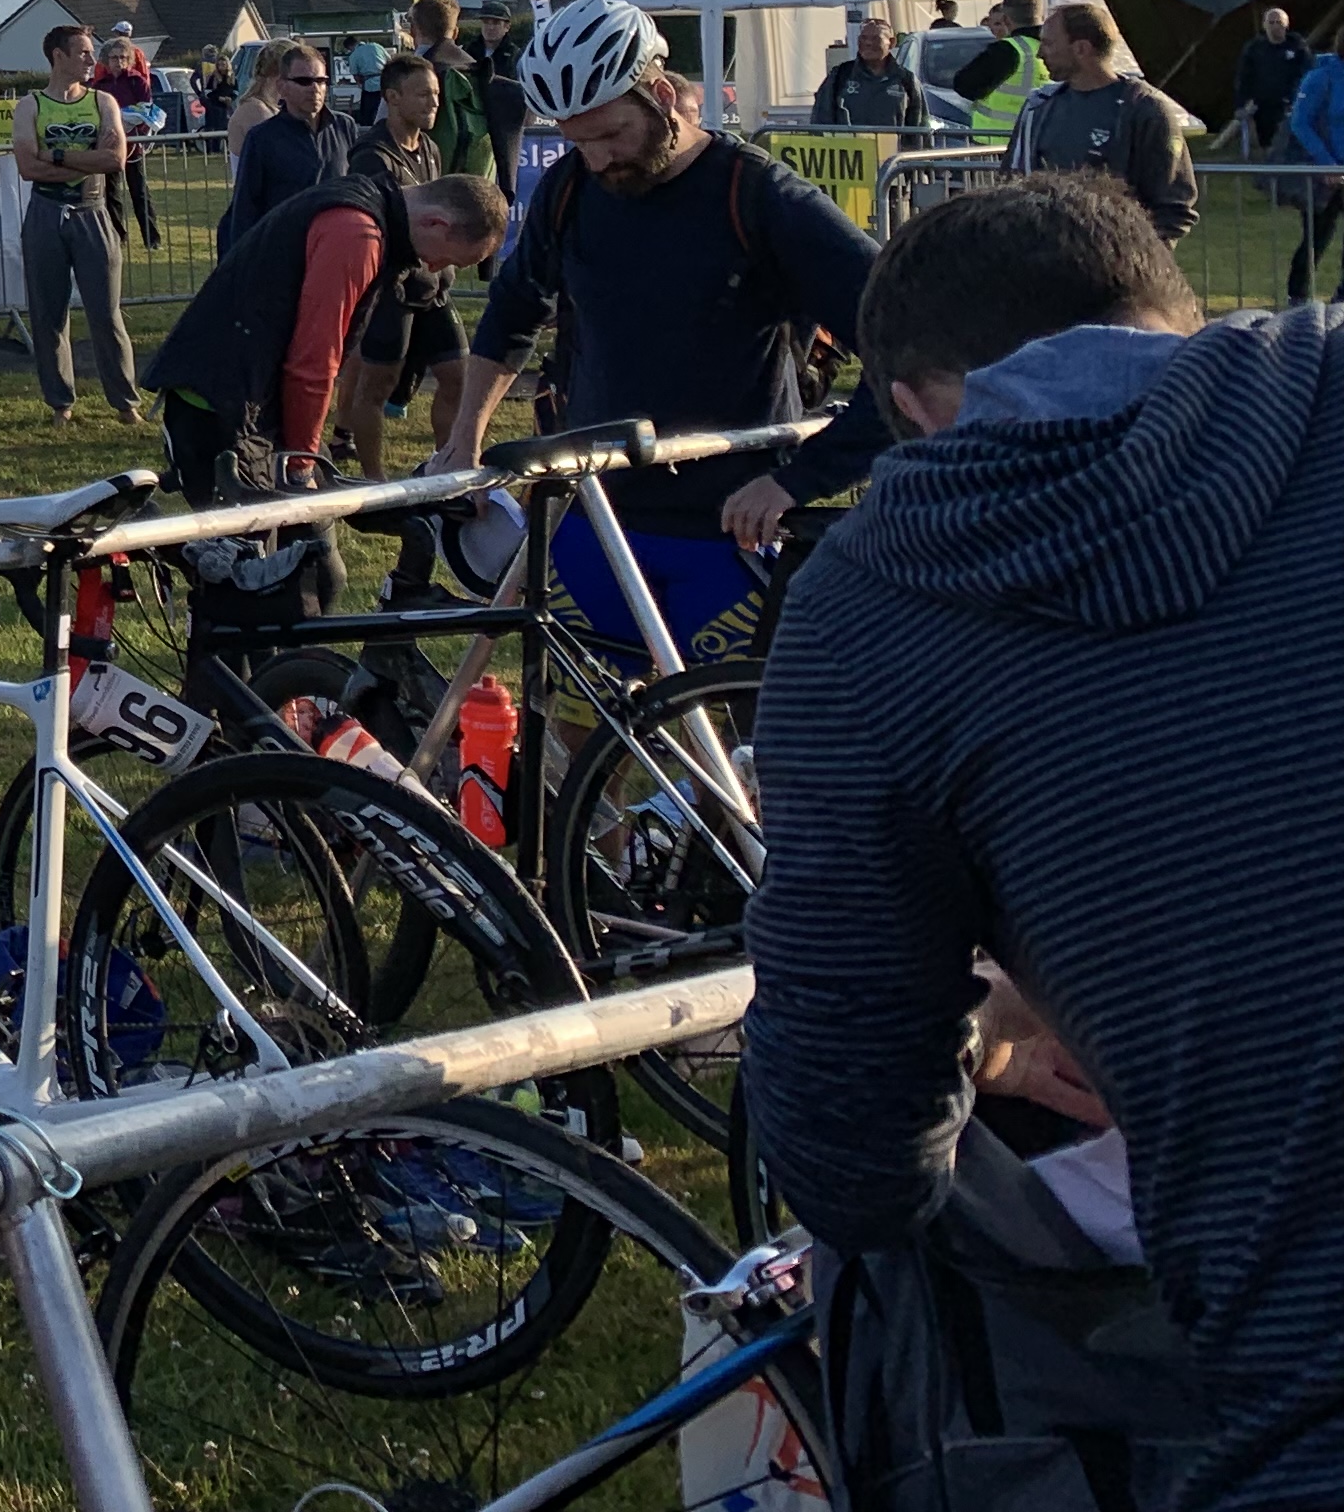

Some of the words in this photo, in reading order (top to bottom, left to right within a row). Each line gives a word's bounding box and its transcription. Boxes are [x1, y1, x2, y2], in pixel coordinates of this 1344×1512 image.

[780, 146, 864, 181] SWIM
[98, 691, 188, 765] 96
[358, 803, 485, 899] PR-2
[79, 956, 109, 1096] PR-2
